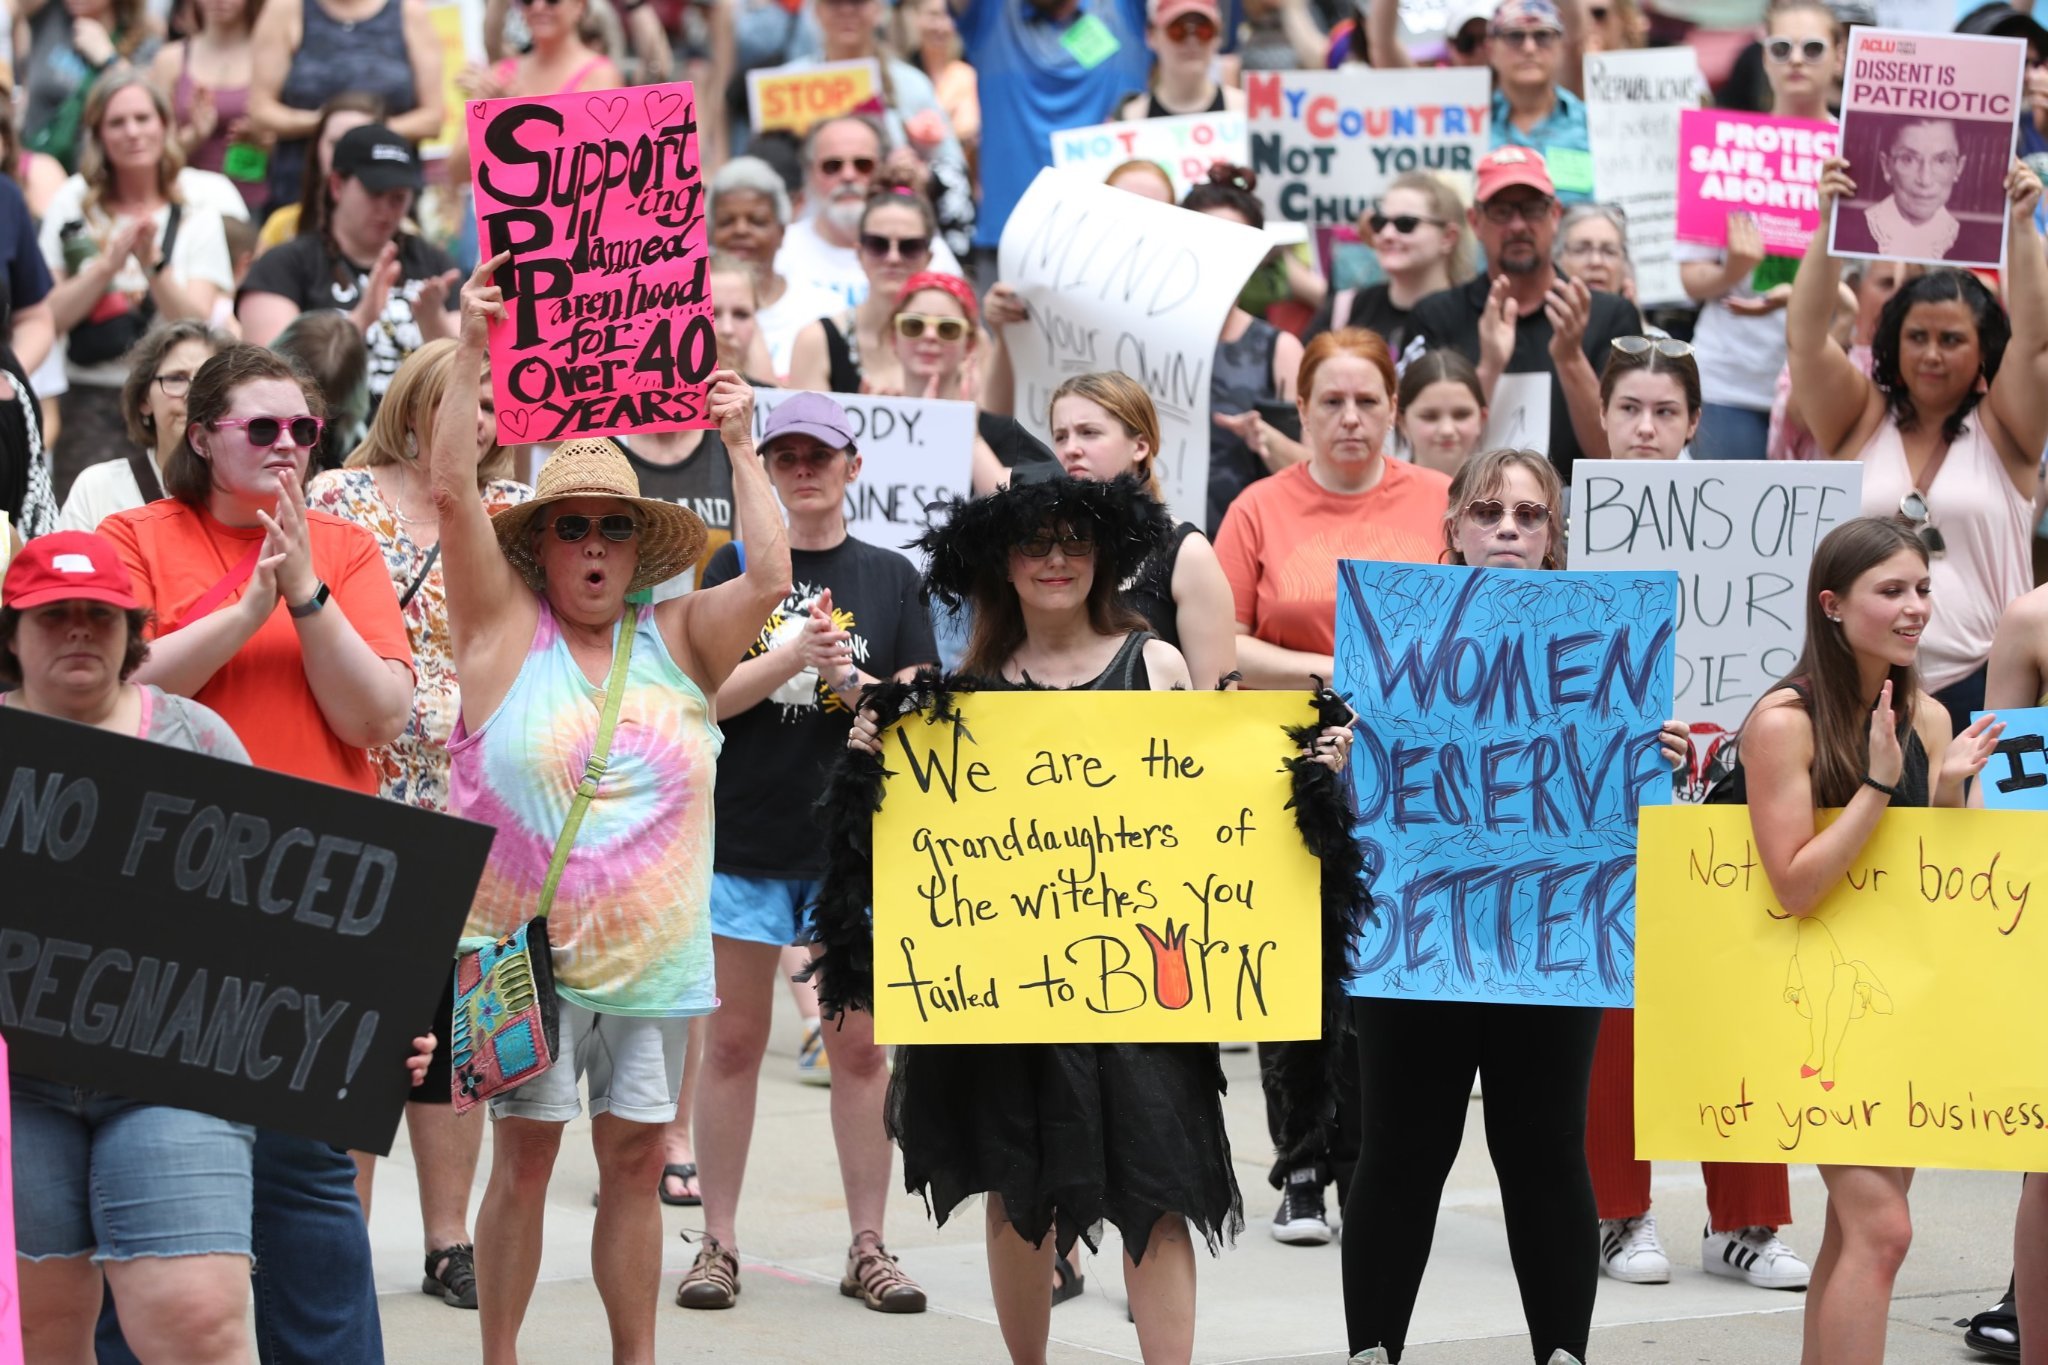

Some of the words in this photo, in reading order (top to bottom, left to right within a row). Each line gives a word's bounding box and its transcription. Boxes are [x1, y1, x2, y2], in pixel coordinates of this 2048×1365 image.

[1856, 58, 1933, 84] DISSENT
[1938, 65, 1956, 86] IS
[1860, 38, 1896, 53] ACLU
[763, 76, 856, 119] STOP
[1248, 72, 1306, 120] MY
[1306, 95, 1488, 139] COUNTRY
[1853, 83, 2010, 115] PATRIOTIC
[1066, 131, 1137, 161] NOT
[1251, 133, 1336, 175] NOT
[1371, 145, 1472, 175] YOUR
[1689, 145, 1774, 180] SAFE,
[1279, 182, 1380, 222] CHU
[1699, 173, 1819, 211] ABORTI
[1018, 199, 1200, 318] MIND
[508, 356, 628, 404] Over
[634, 314, 717, 390] 40
[550, 317, 638, 364] for
[1115, 330, 1203, 408] OWN
[531, 390, 702, 441] YEARS
[844, 405, 924, 447] ODY.
[1584, 476, 1733, 555] BANS
[1752, 484, 1846, 557] OFF
[1338, 558, 1673, 728] WOMEN
[897, 708, 997, 802] We
[1026, 751, 1117, 787] are
[1142, 737, 1205, 779] the
[0, 767, 98, 862] NO
[121, 791, 398, 936] FORCED
[913, 815, 1179, 895] granddaughters
[1217, 808, 1256, 846] of
[1690, 827, 1758, 892] Not
[1919, 836, 2031, 936] body
[918, 873, 998, 928] the
[1011, 869, 1158, 919] witches
[1184, 873, 1254, 944] you
[1343, 837, 1637, 996] BETTER
[0, 929, 380, 1100] REGNANCY!
[888, 937, 1000, 1022] failed
[1019, 955, 1075, 1008] to
[1700, 1077, 1754, 1138] not
[1777, 1100, 1881, 1151] your
